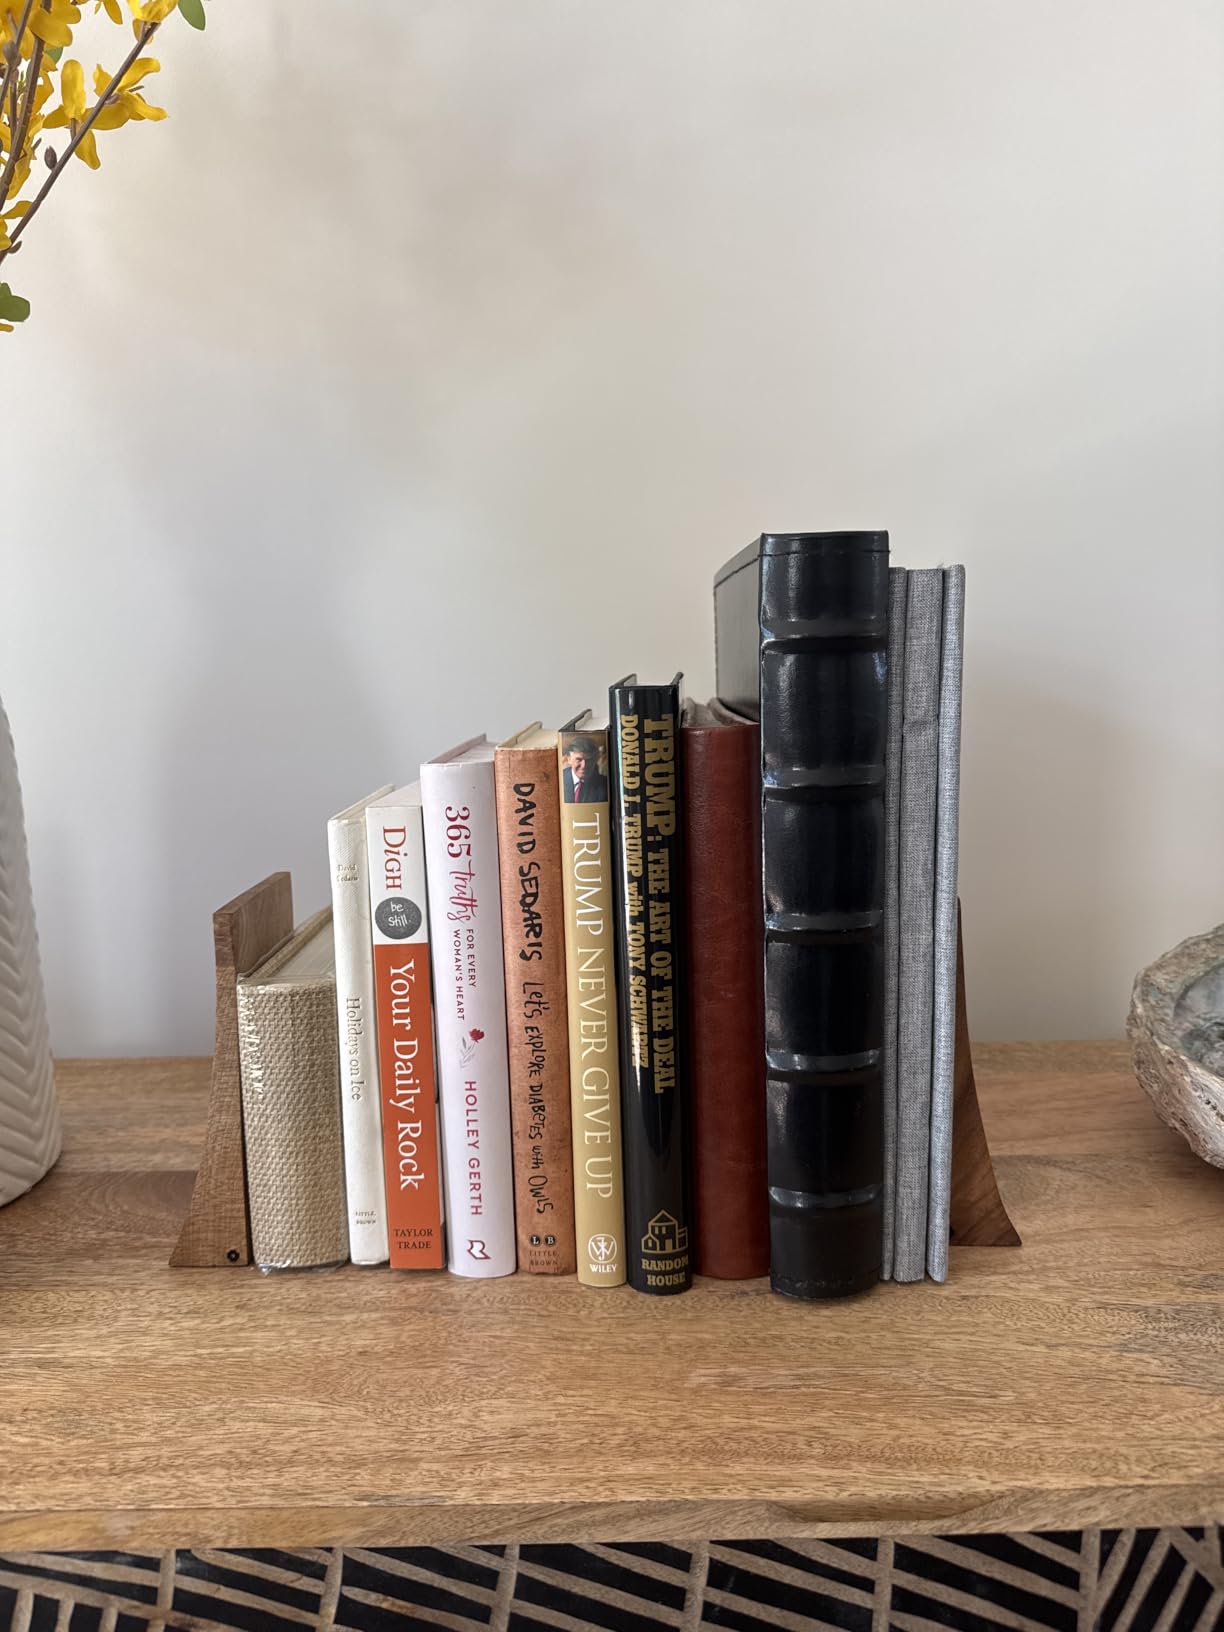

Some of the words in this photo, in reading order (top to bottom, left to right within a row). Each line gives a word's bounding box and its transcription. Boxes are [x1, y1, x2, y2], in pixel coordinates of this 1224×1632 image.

[620, 714, 640, 789] DONALD
[643, 713, 676, 842] TRUMP:
[445, 806, 472, 858] 365
[513, 782, 536, 854] DAVID
[623, 813, 643, 878] TRUMP
[446, 859, 479, 923] truths
[572, 812, 604, 936] TRUMP
[648, 848, 670, 894] THE
[390, 902, 404, 912] be
[518, 861, 543, 962] SEDARIS
[627, 881, 644, 916] with
[649, 902, 671, 944] ART
[453, 929, 463, 981] WOMAN'S
[466, 928, 474, 949] FOR
[628, 922, 646, 971] TONY
[468, 951, 477, 988] EVERY
[650, 951, 673, 985] OF
[390, 959, 415, 1031] Your
[456, 986, 465, 1021] HEART
[577, 948, 608, 1060] NEVER
[652, 986, 674, 1031] THE
[345, 997, 362, 1056] Holidays
[350, 1059, 360, 1076] on
[351, 1080, 365, 1100] Ice
[390, 1038, 421, 1113] Daily
[653, 1038, 675, 1094] DEAL
[464, 1081, 480, 1150] HOLLEY
[581, 1067, 612, 1145] GIVE
[397, 1120, 425, 1190] Rock
[531, 1145, 543, 1169] with
[585, 1155, 613, 1199] UP
[468, 1158, 483, 1216] GERTH
[393, 1228, 433, 1237] TAYLOR
[398, 1241, 432, 1249] TRADE
[589, 1263, 617, 1272] WILEY
[646, 1272, 685, 1286] HOUSE
